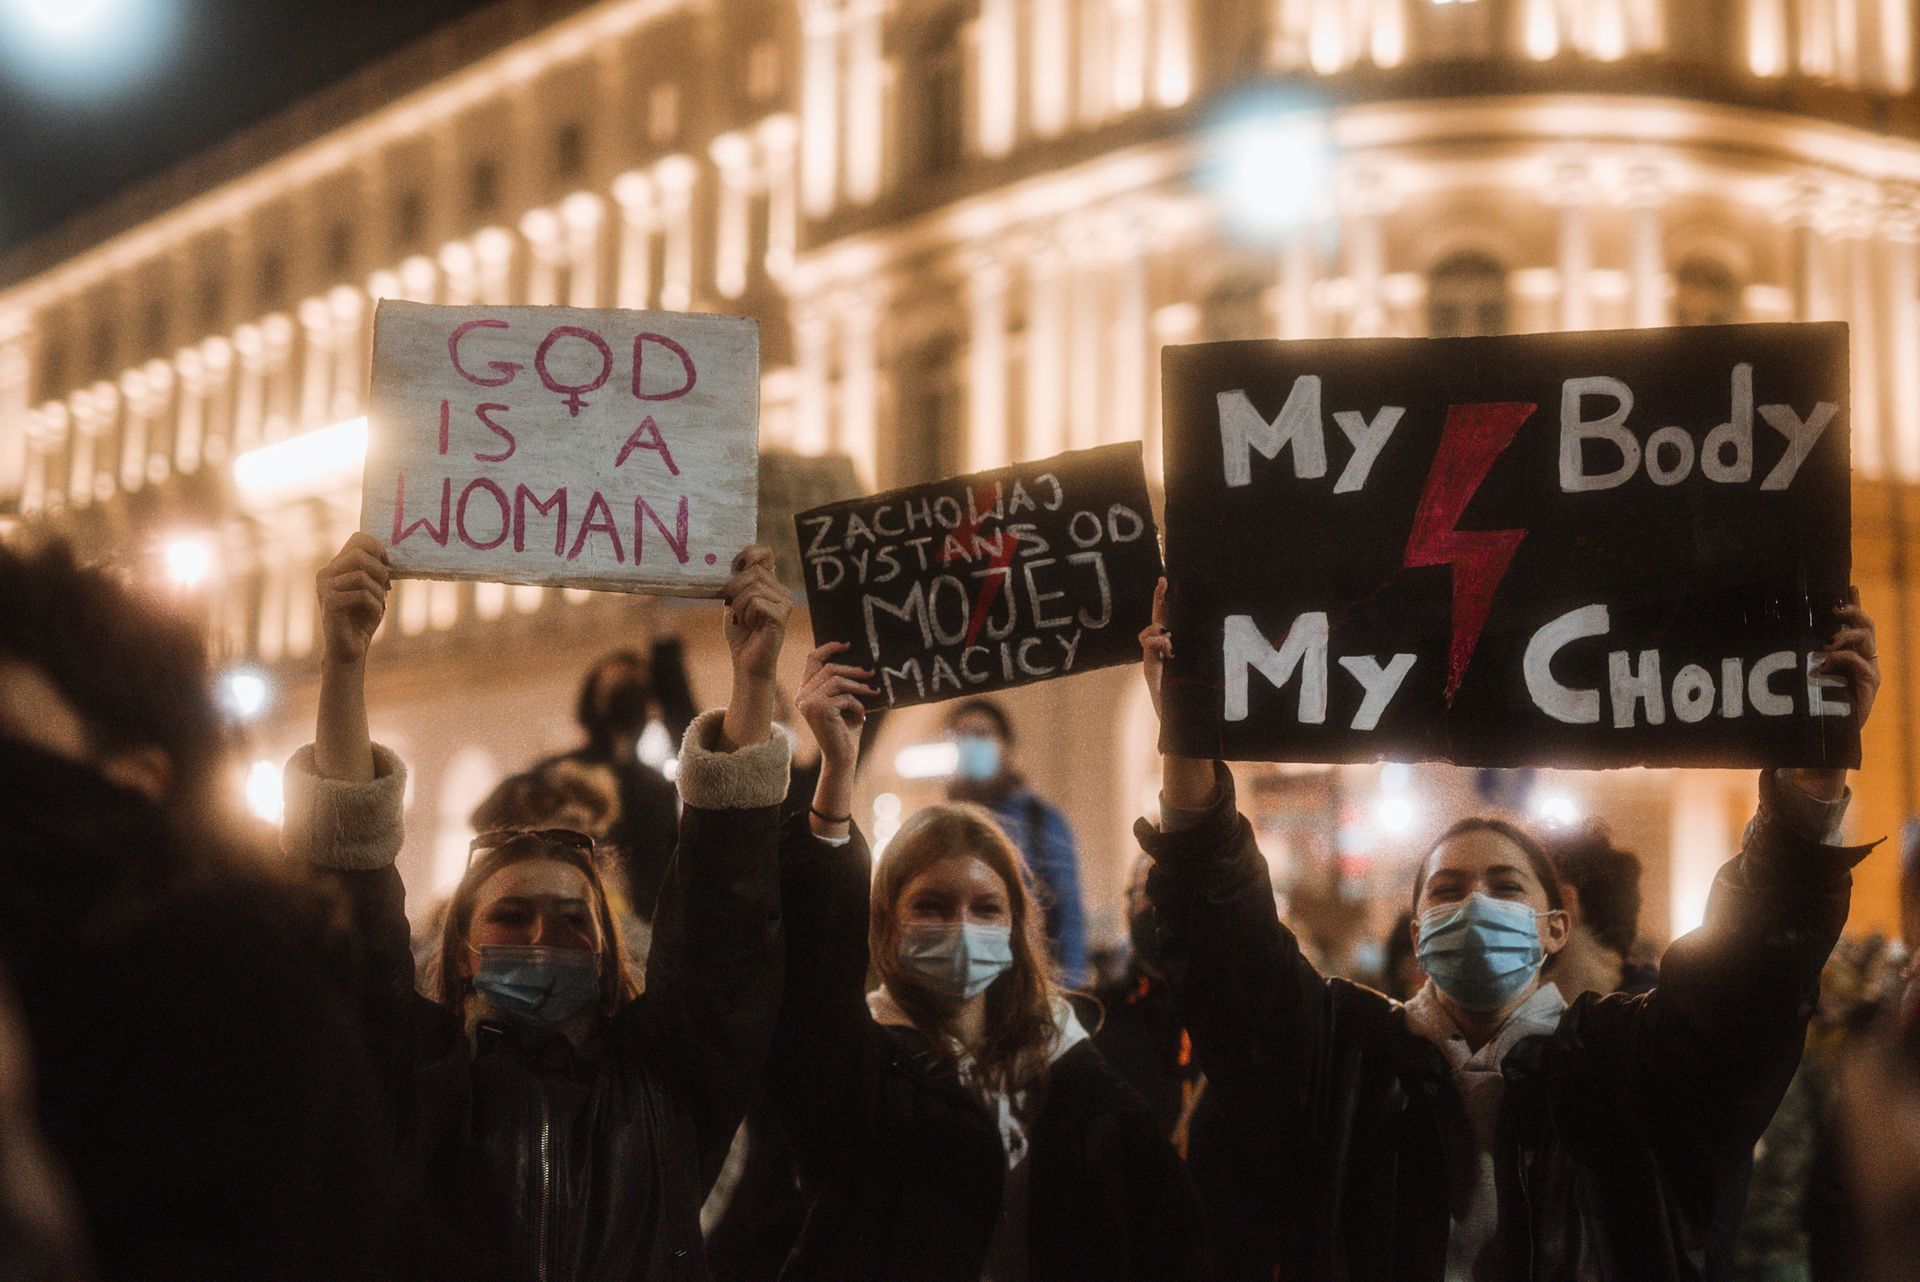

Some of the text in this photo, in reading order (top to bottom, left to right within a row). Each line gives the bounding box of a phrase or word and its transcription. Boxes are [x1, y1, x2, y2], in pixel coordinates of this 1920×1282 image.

[448, 319, 697, 418] GOD
[439, 399, 681, 476] IS A
[1216, 362, 1840, 494] My Body
[391, 475, 718, 567] WOMAN.
[803, 472, 1064, 559] ZACHOWAJ
[810, 503, 1144, 592] DYSTANS OD
[862, 551, 1113, 662] MOJEJ
[881, 628, 1083, 708] MACICY
[1223, 611, 1417, 731] My
